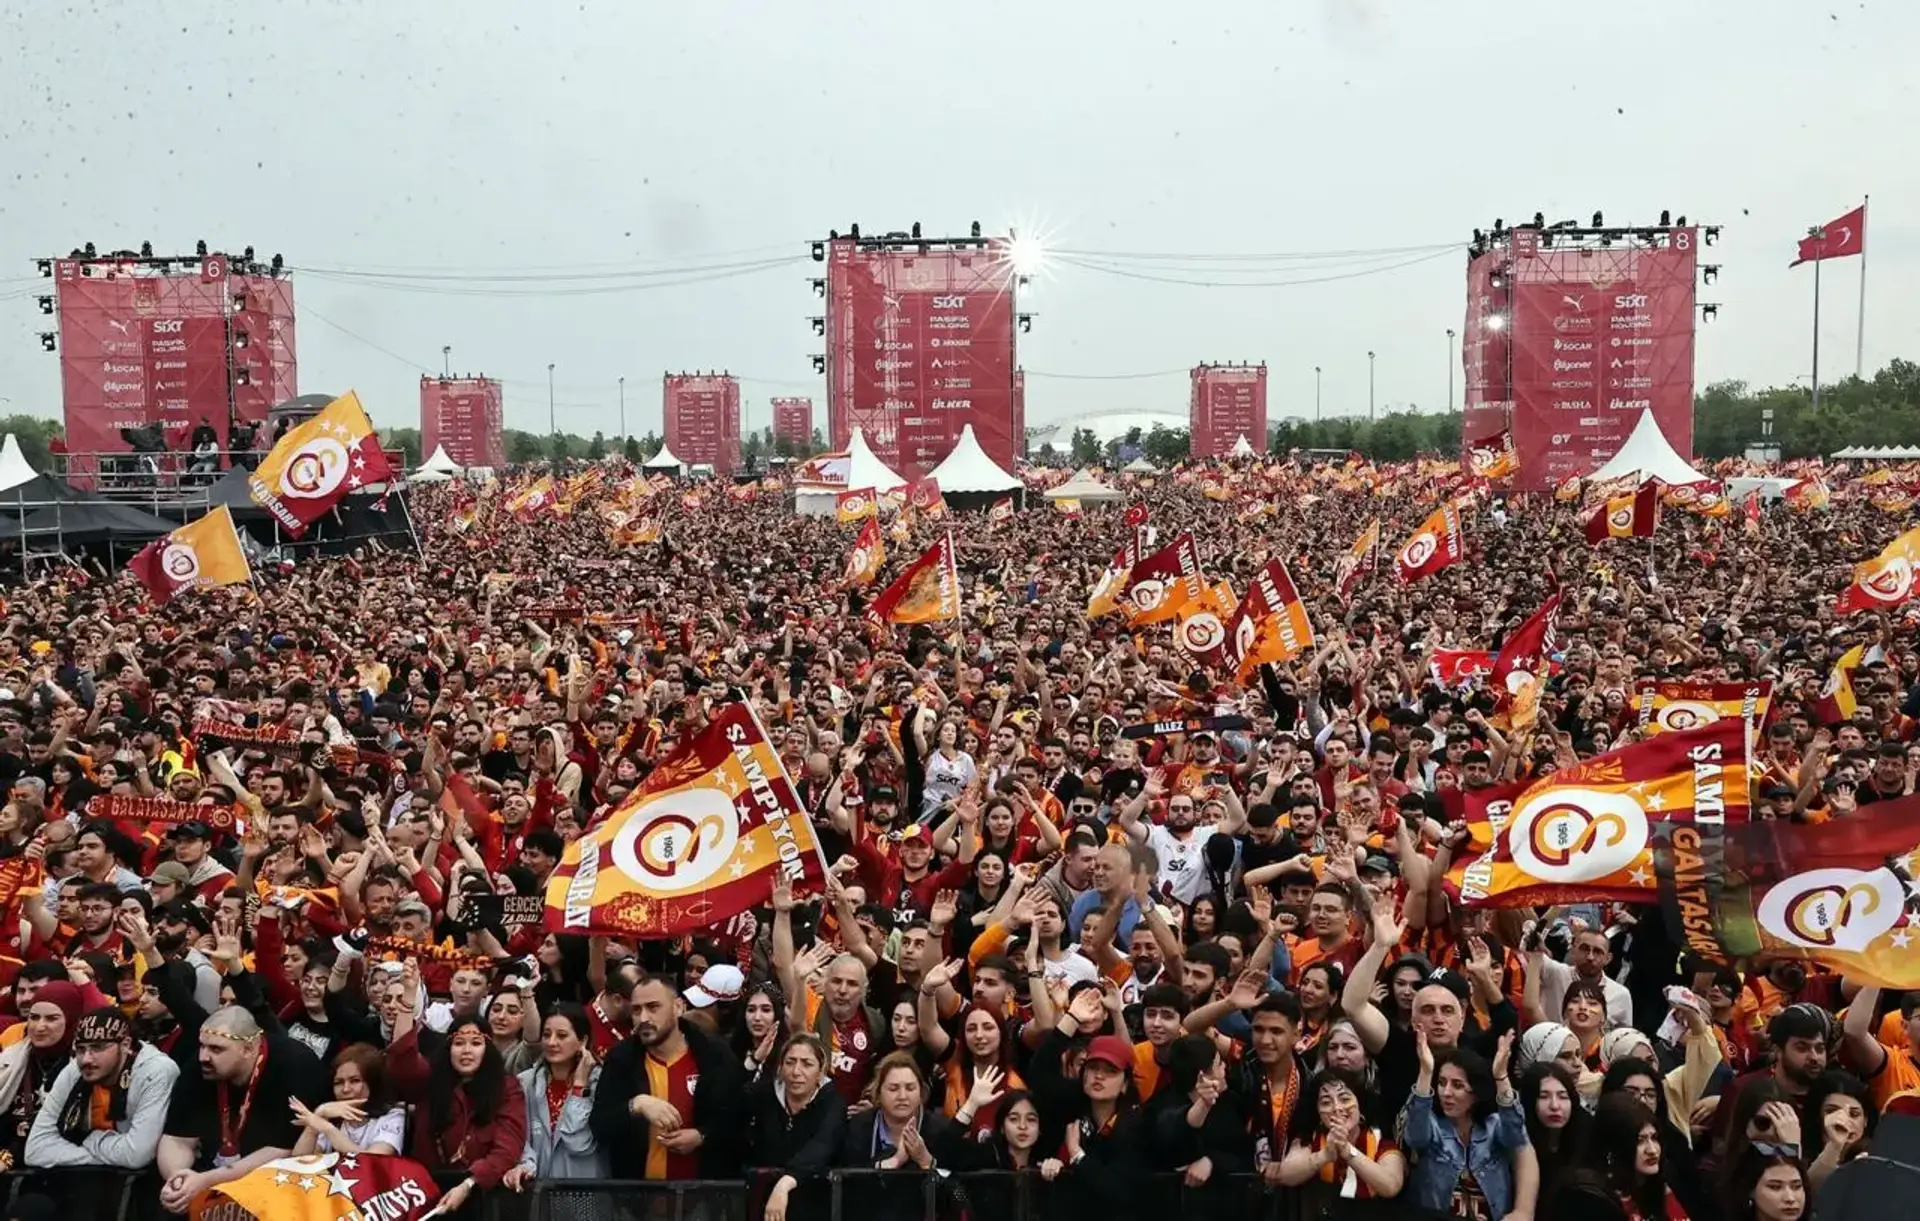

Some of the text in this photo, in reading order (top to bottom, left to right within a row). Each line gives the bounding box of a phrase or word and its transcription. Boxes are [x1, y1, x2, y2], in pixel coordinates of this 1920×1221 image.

[1675, 232, 1691, 250] 8
[207, 261, 220, 277] 6
[933, 295, 966, 308] SIXT
[1615, 295, 1648, 308] SIXT
[153, 320, 183, 332] SIXT
[1154, 721, 1184, 733] ALLEZ
[936, 773, 961, 786] SIXT
[110, 794, 205, 821] GALATASARAY
[1558, 822, 1568, 846] 1905
[663, 835, 674, 859] 1905
[1816, 902, 1828, 926] 1905
